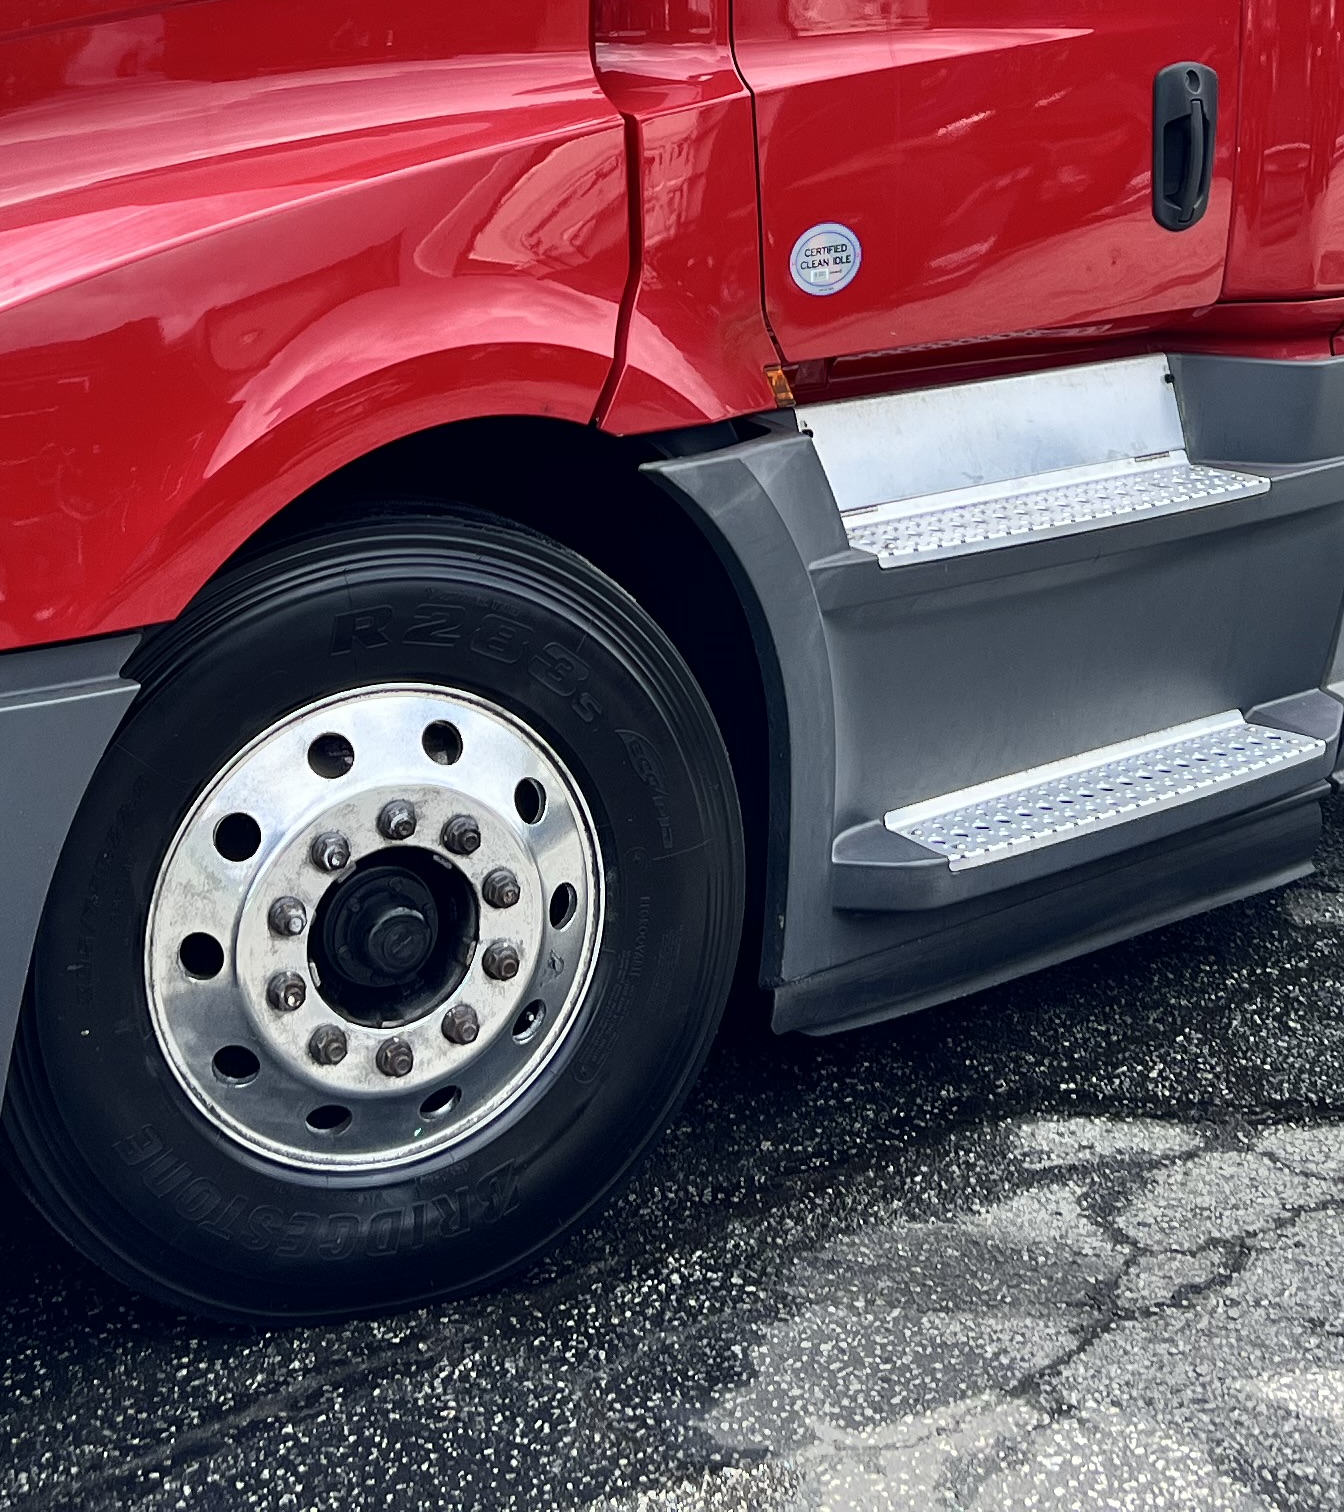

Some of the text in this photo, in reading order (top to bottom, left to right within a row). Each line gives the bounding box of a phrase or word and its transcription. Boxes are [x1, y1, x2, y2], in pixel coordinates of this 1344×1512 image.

[804, 243, 848, 257] CERTIFIED
[800, 254, 851, 270] CLEAN IDLE
[111, 1123, 522, 1261] BRIDGESTONE
